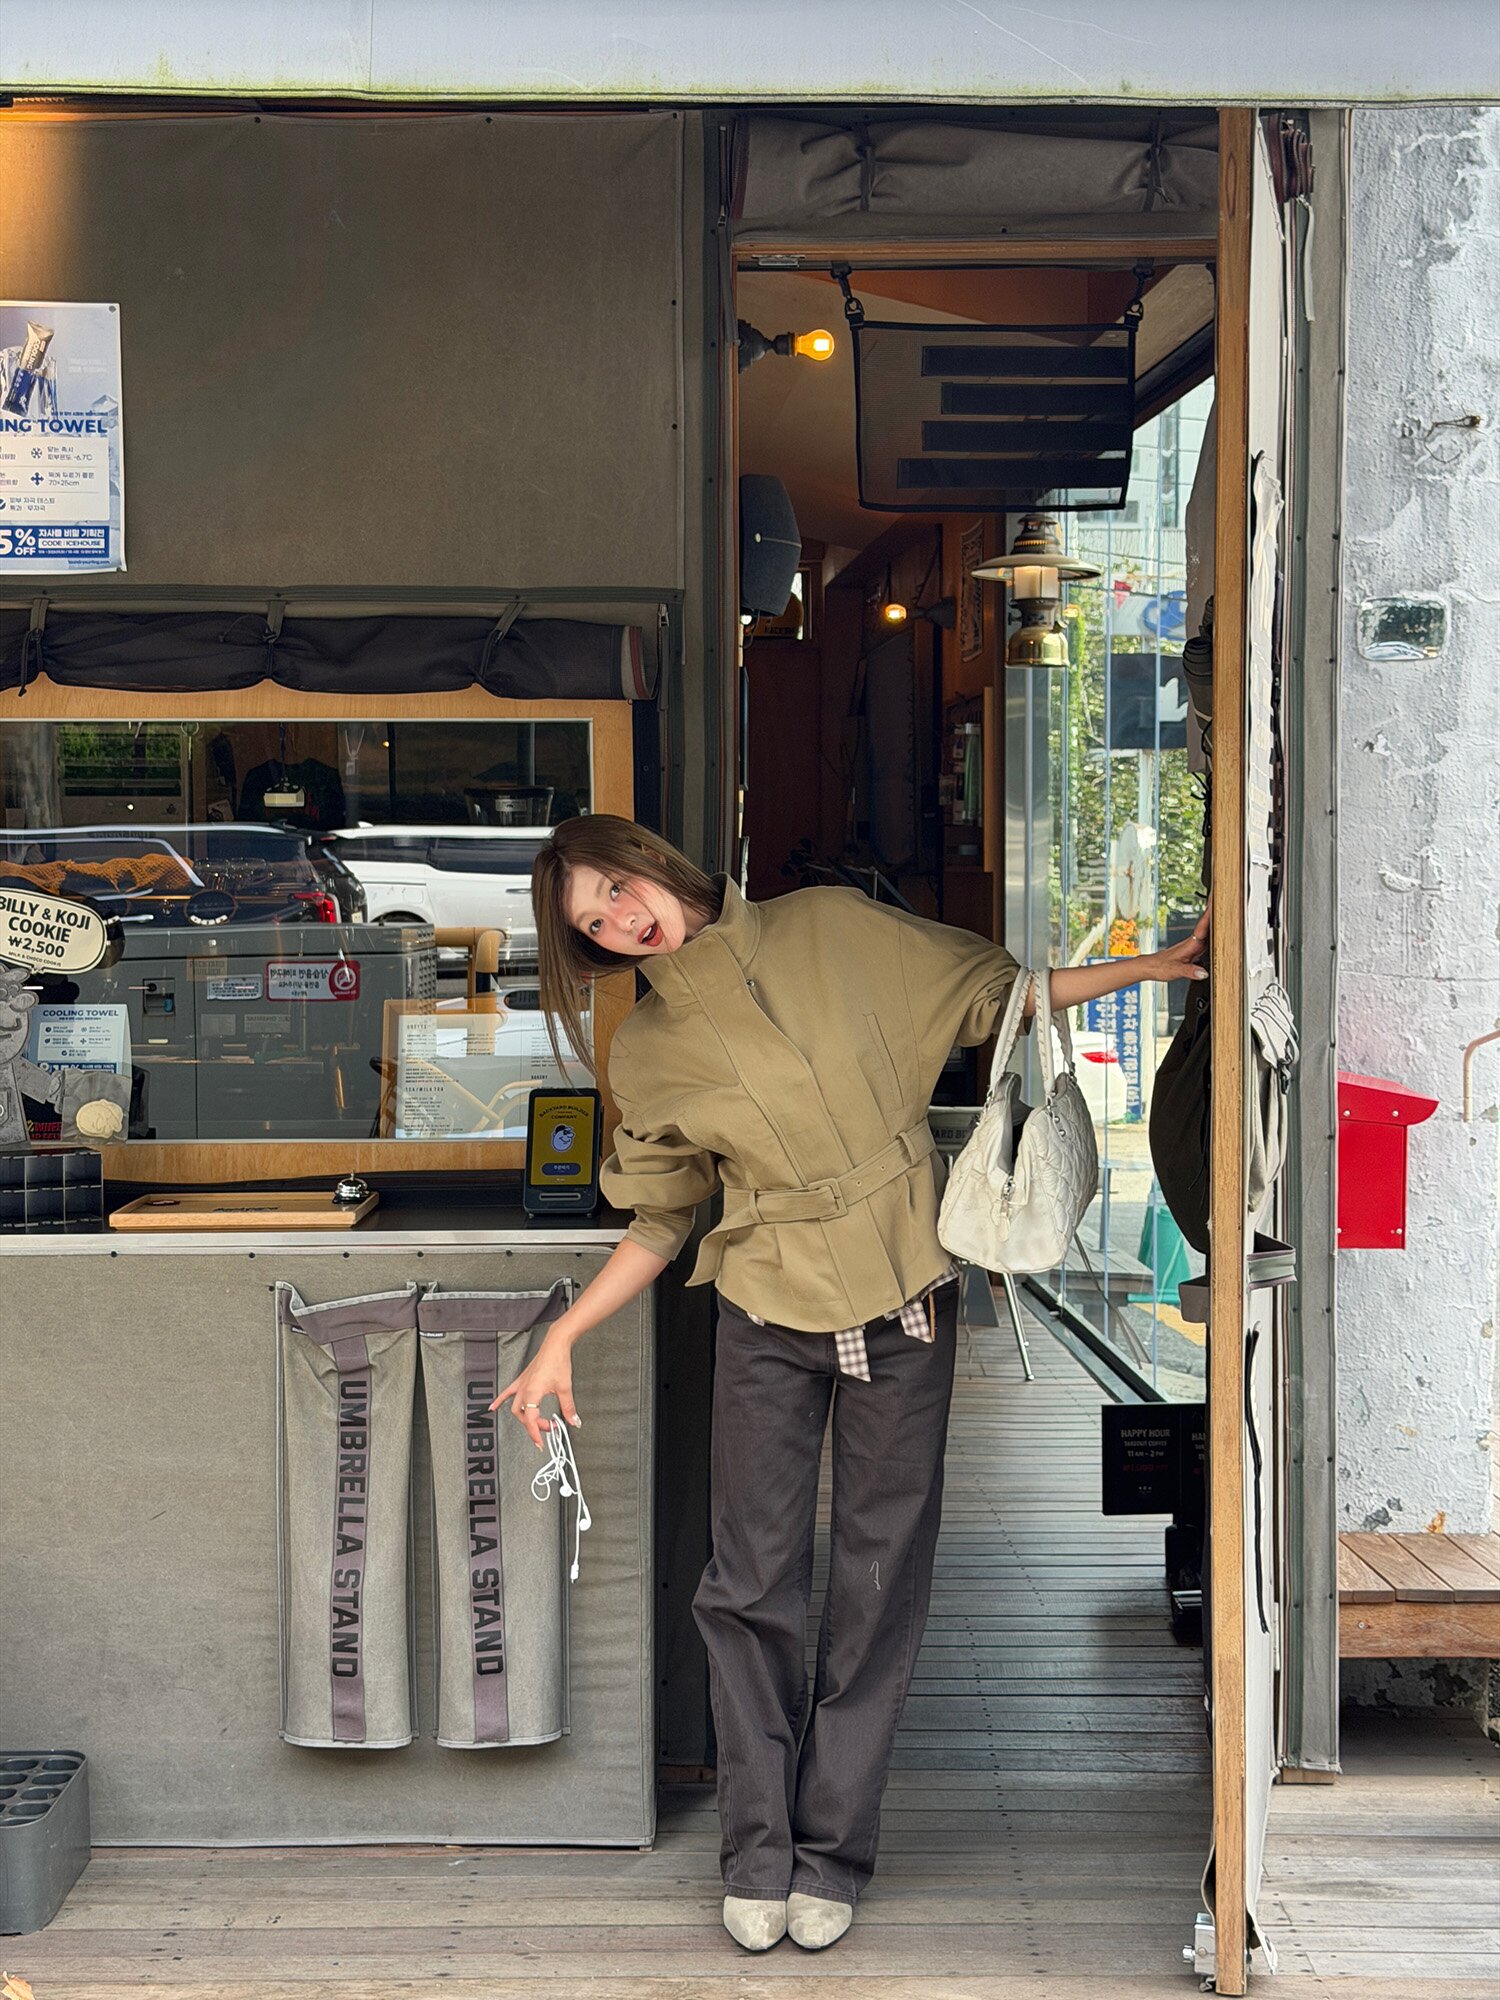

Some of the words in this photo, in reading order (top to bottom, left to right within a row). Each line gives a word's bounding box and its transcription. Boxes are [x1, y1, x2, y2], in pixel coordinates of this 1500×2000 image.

[37, 419, 108, 433] TOWEL
[38, 529, 62, 538] 자사몰
[63, 529, 80, 538] 비밀
[14, 547, 36, 556] OFF
[0, 896, 40, 917] BILLY
[41, 907, 52, 921] &
[55, 909, 92, 930] KOJI
[8, 916, 72, 943] COOKIE
[8, 935, 66, 958] ₩2,500
[42, 1009, 85, 1017] COOLING
[85, 1009, 120, 1017] TOWEL
[1120, 1429, 1148, 1438] HAPPY
[1148, 1429, 1171, 1437] HOUR
[336, 1380, 368, 1557] UMBRELLA
[466, 1380, 498, 1559] UMBRELLA
[332, 1567, 362, 1679] STAND
[471, 1567, 505, 1678] STAND
